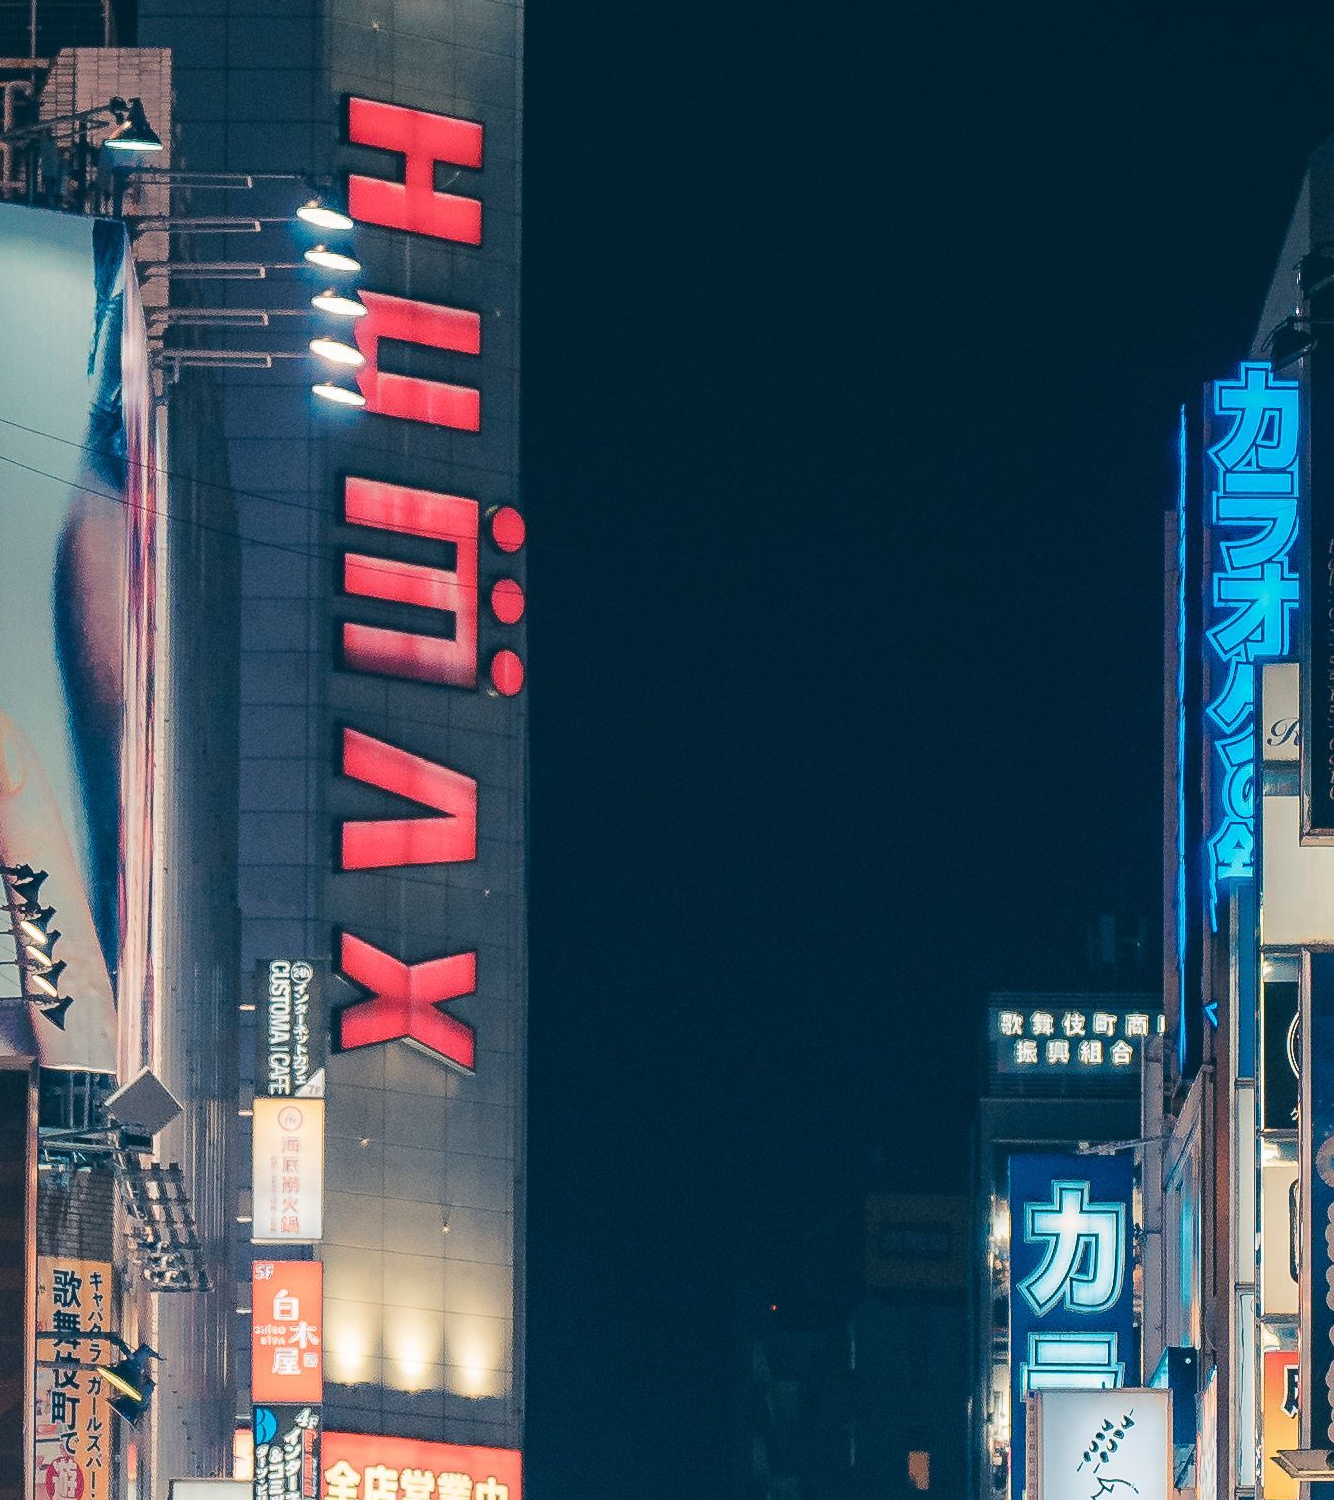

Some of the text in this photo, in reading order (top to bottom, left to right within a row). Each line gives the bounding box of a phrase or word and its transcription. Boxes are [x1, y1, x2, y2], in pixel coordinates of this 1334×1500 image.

[1017, 1040, 1134, 1064] 振興組合
[269, 1055, 291, 1096] CAFE
